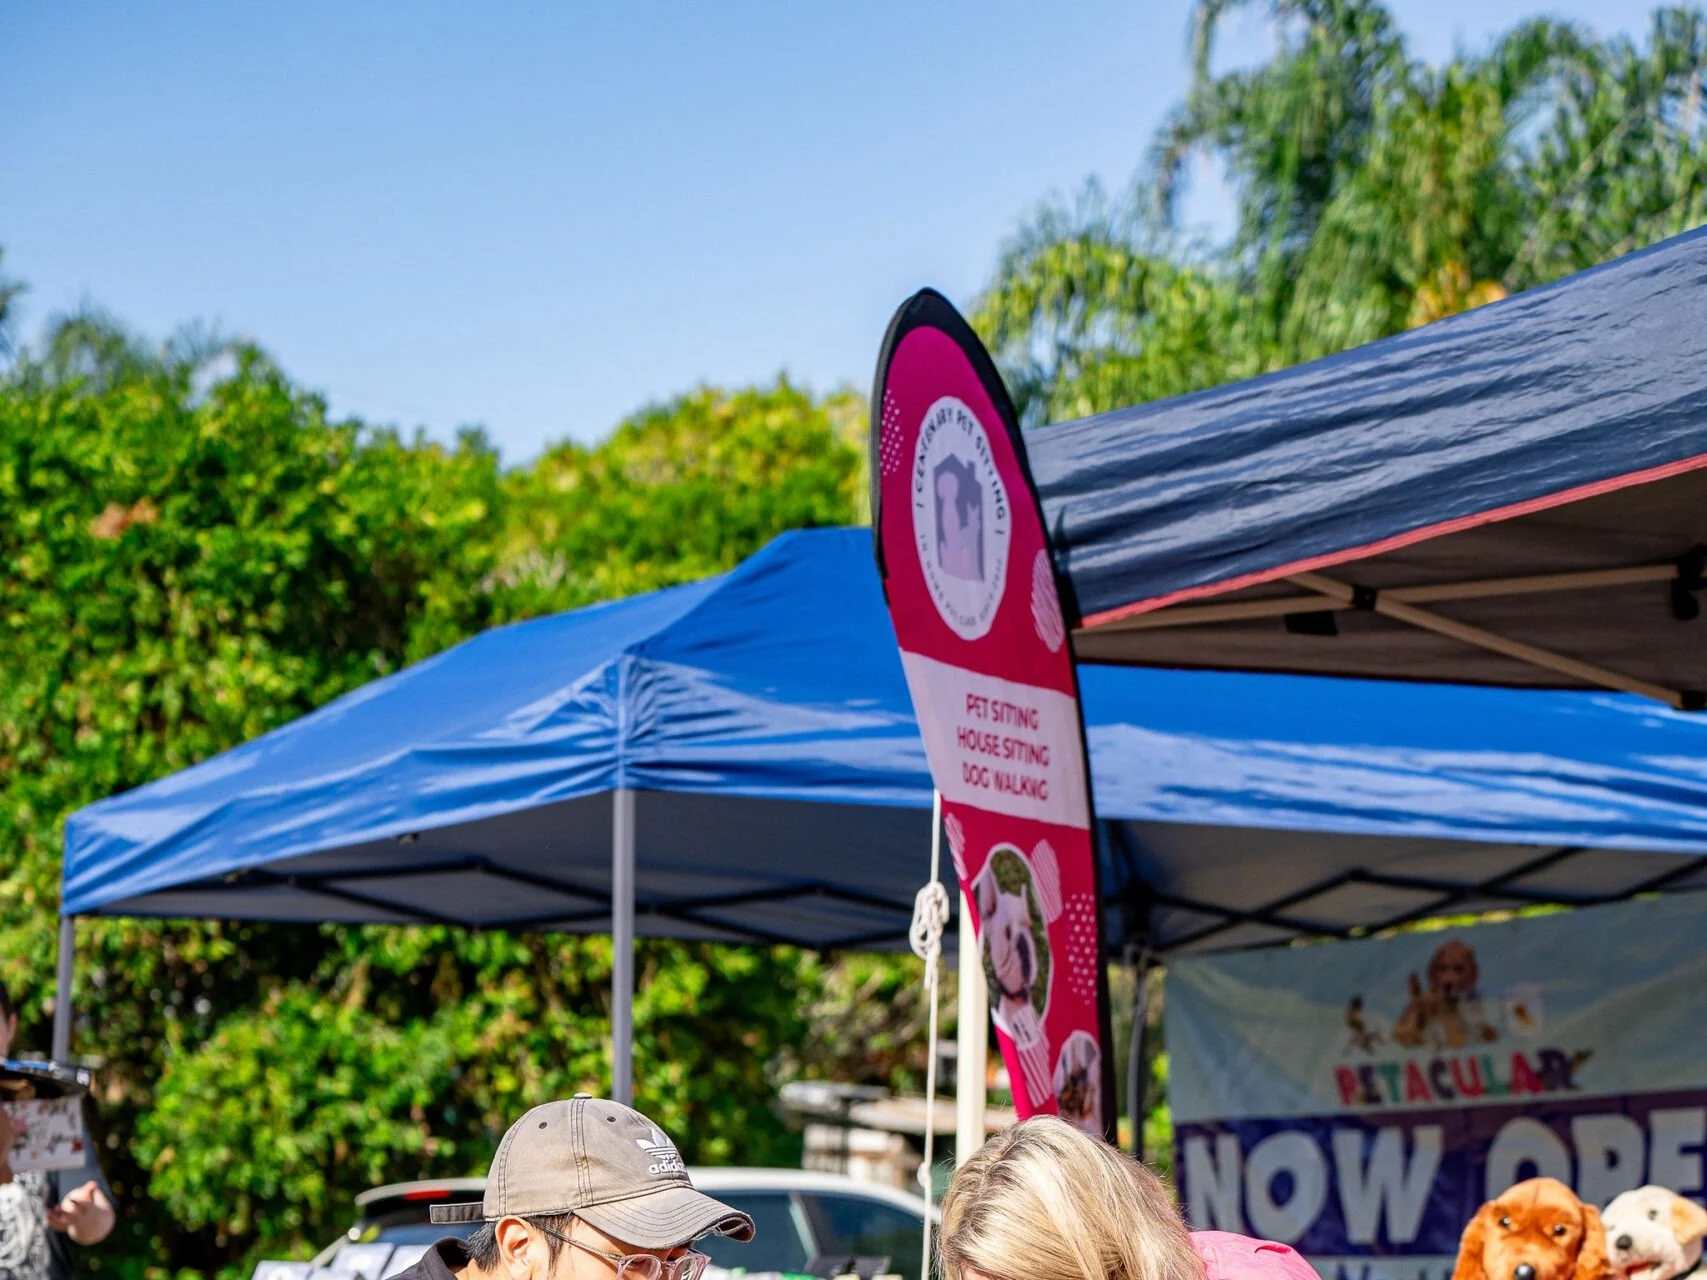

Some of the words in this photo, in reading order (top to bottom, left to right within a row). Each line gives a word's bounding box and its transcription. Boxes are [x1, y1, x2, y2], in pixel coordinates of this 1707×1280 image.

[956, 410, 975, 437] PET
[975, 436, 1006, 521] SITTING
[966, 693, 988, 720] PET
[957, 726, 1000, 758] HOUSE
[962, 761, 989, 789] DOG
[1333, 1048, 1580, 1106] PETACULAR
[1184, 1123, 1445, 1246] NOW
